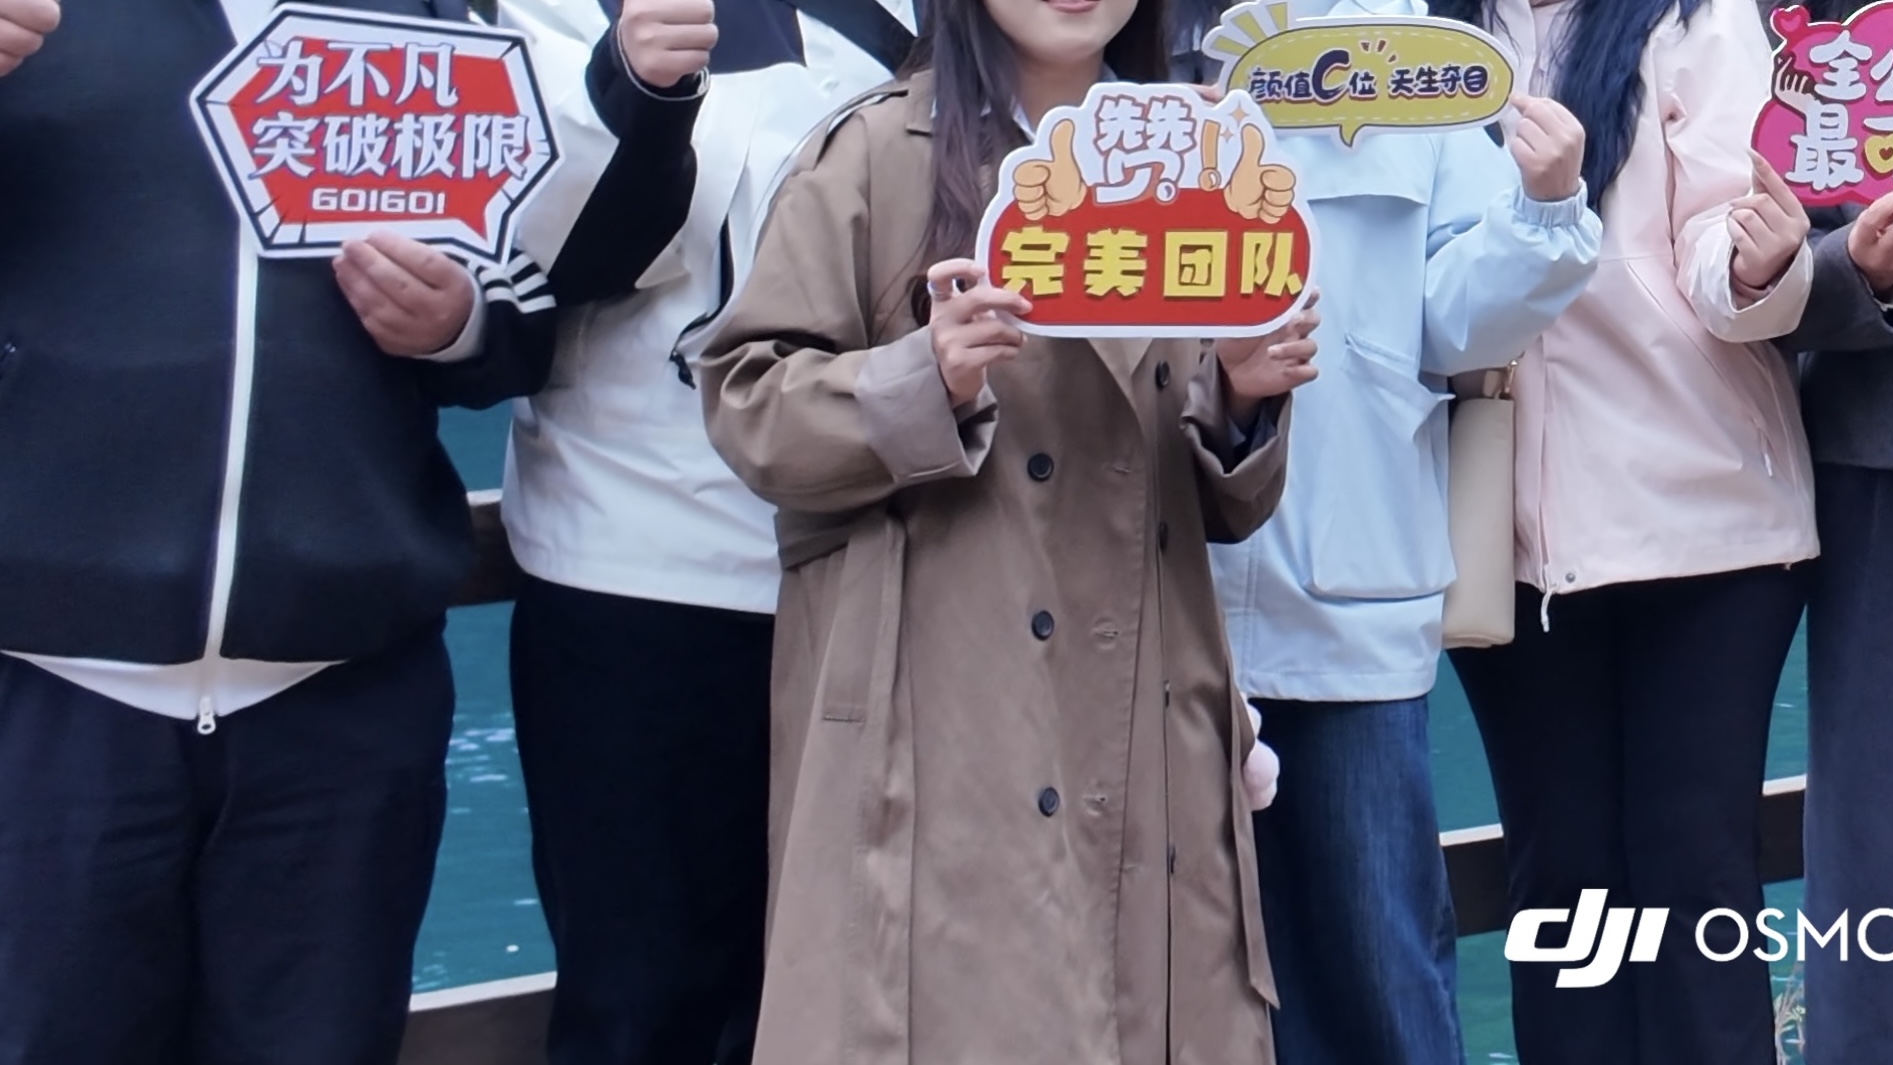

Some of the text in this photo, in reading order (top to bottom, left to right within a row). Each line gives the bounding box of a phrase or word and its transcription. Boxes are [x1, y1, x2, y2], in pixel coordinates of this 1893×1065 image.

[256, 38, 459, 106] 为不凡
[250, 111, 531, 180] 突破极限
[1000, 226, 1303, 298] 完美团队
